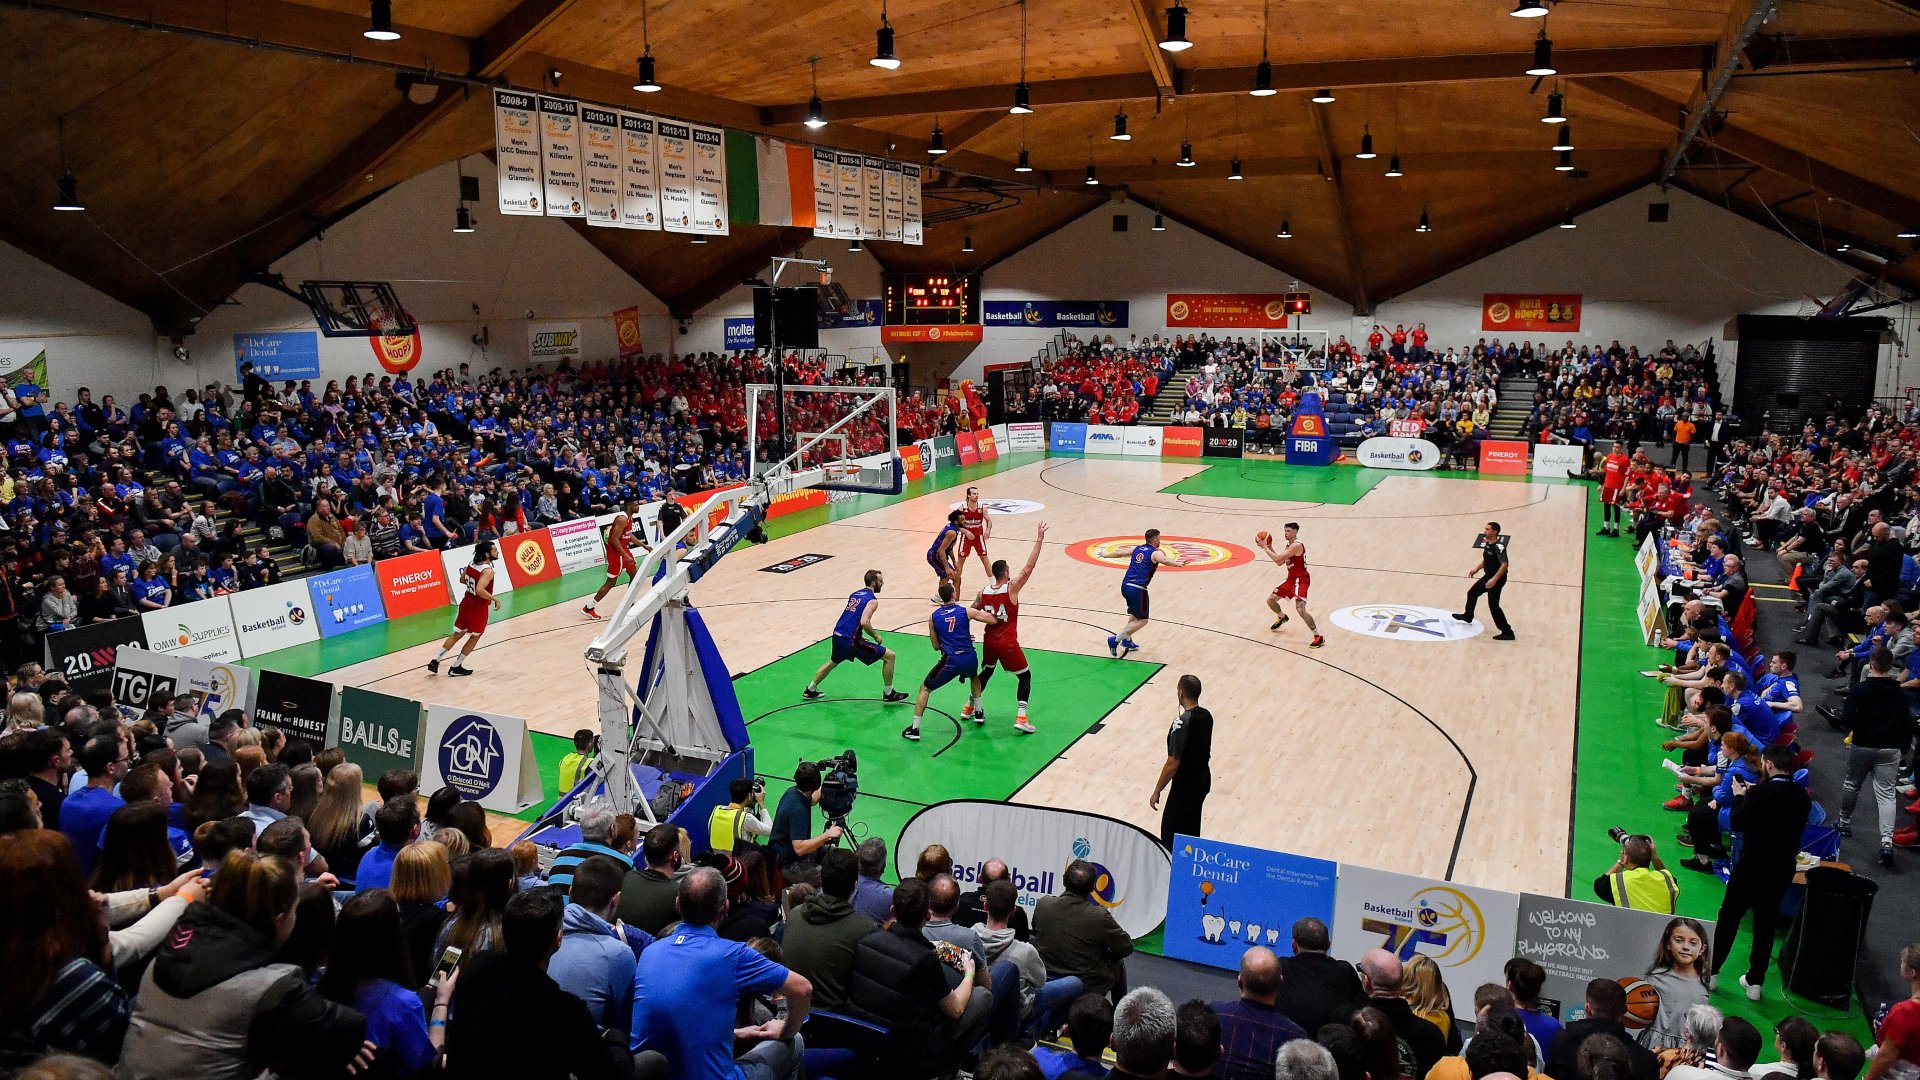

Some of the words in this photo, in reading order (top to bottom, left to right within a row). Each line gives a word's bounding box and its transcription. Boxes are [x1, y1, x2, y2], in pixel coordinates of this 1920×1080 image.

[500, 95, 527, 107] 2008-9
[544, 101, 574, 113] 2009-10
[586, 111, 613, 124] 2010-11
[624, 119, 651, 131] 2011-12
[662, 125, 687, 137] 2012-13
[510, 138, 528, 147] Men's
[695, 132, 719, 143] 2013-14
[500, 146, 514, 154] UCC
[552, 143, 569, 152] Men's
[508, 165, 534, 174] Women's
[550, 170, 576, 179] Women's
[562, 180, 579, 189] Mercy
[503, 199, 528, 207] Basketball
[985, 311, 1022, 321] Basketball
[1056, 312, 1095, 321] Basketball
[532, 329, 577, 349] SUBWAY
[250, 347, 277, 357] Dental
[386, 342, 411, 358] HOOPS
[1392, 420, 1420, 432] RED
[1294, 440, 1319, 453] FIBA
[1369, 451, 1405, 460] Basketball
[521, 546, 536, 563] HULA
[392, 570, 434, 588] PINERGY
[320, 584, 341, 595] Dental
[390, 589, 401, 597] The
[845, 597, 861, 613] 32
[242, 615, 286, 633] Basketball
[944, 616, 957, 633] 7
[153, 637, 177, 651] OMW
[192, 625, 230, 642] SUPPLIES
[63, 652, 92, 676] 20
[256, 709, 283, 723] FRANK
[293, 716, 326, 733] HONEST
[299, 731, 324, 742] COMPANY
[1194, 847, 1251, 872] DeCare
[1192, 863, 1240, 884] Dental
[1266, 865, 1286, 874] Dental
[1286, 868, 1315, 880] Insurance
[1265, 872, 1275, 880] the
[1274, 873, 1297, 884] Dental
[1296, 877, 1320, 888] Experts
[1364, 902, 1413, 919] Basketball
[1543, 926, 1561, 940] TO
[1563, 927, 1582, 945] MY
[1518, 938, 1610, 961] PLAYGROUND.
